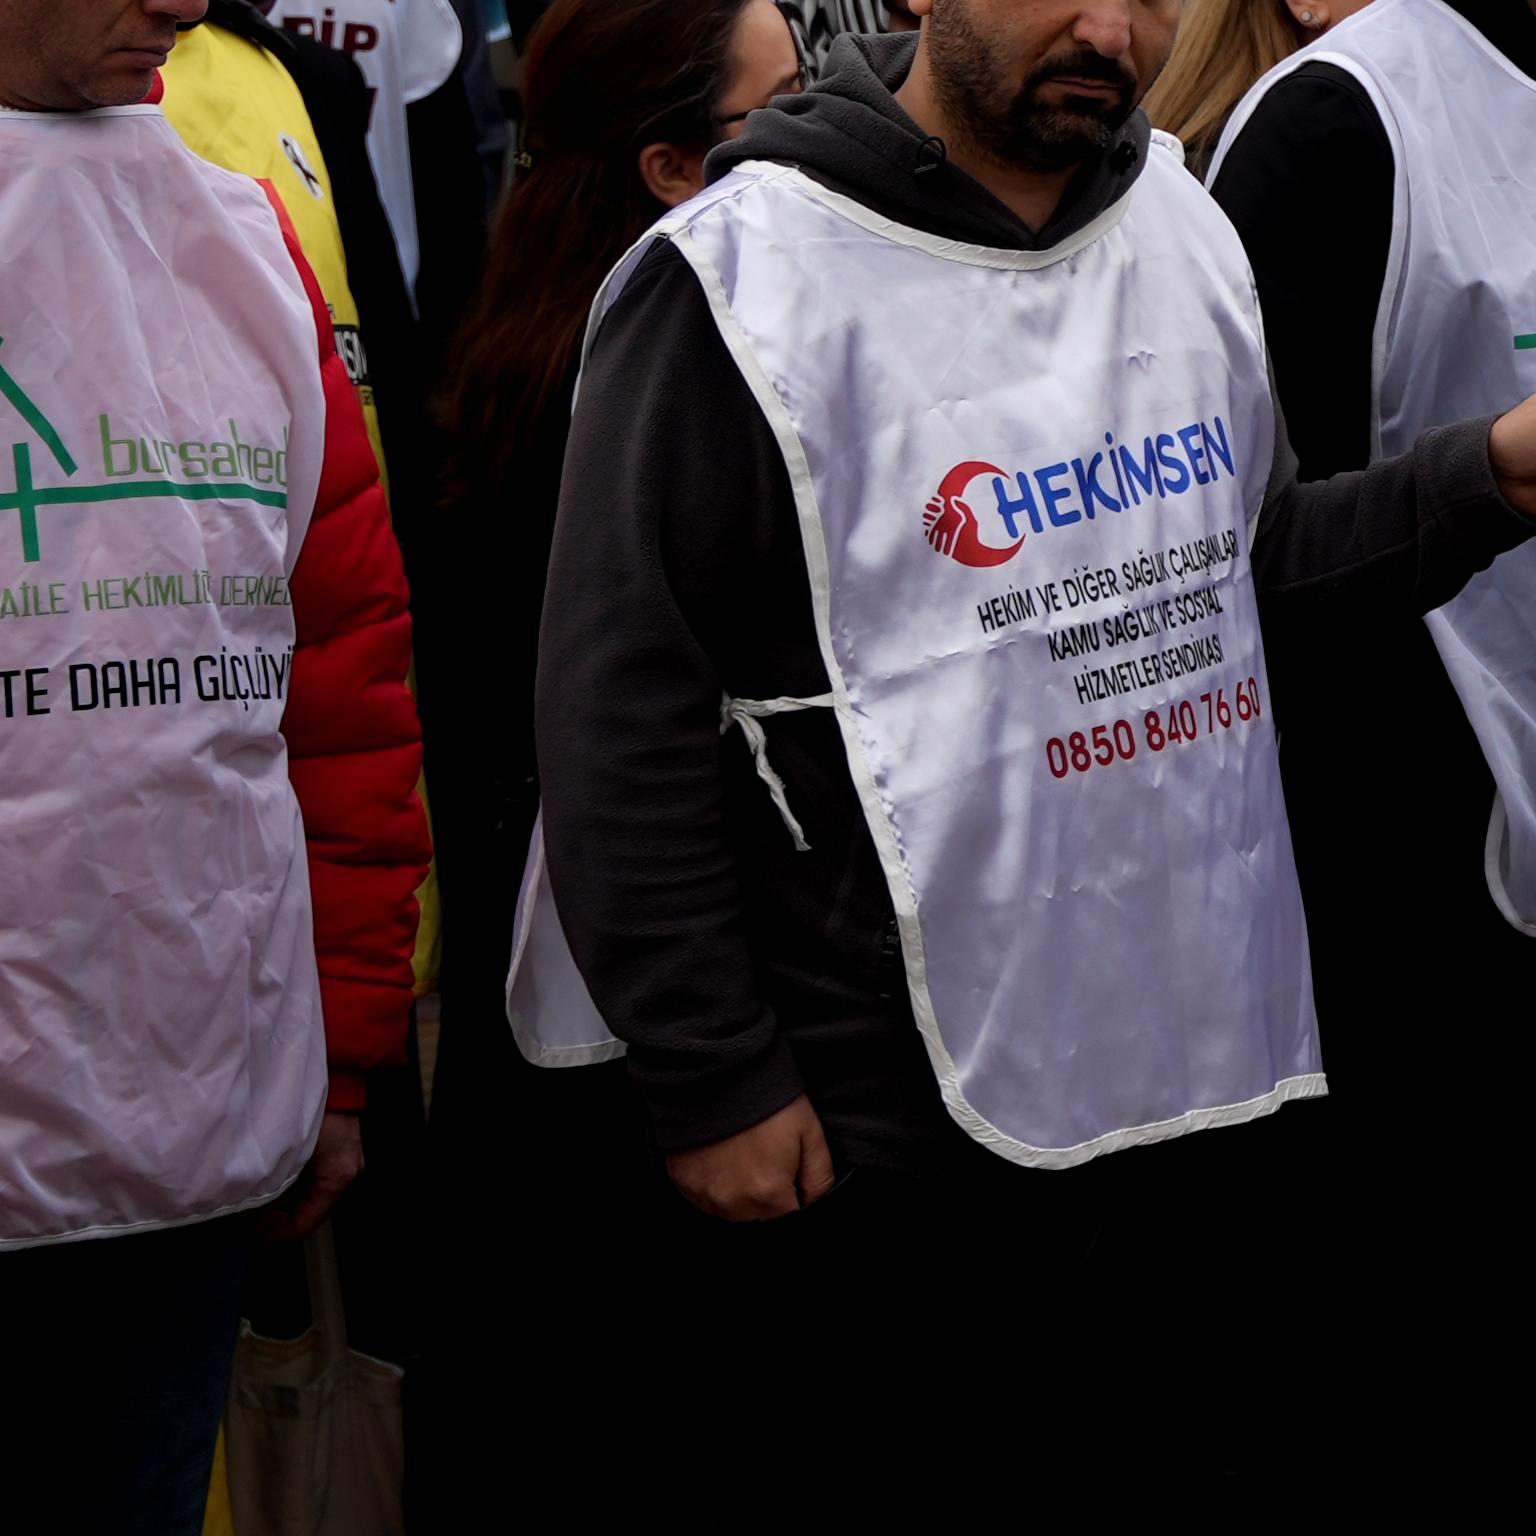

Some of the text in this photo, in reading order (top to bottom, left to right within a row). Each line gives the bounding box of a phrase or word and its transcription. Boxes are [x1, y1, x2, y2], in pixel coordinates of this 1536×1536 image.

[992, 417, 1236, 538] HEKİMSEN
[1, 583, 68, 619] AİLE
[977, 528, 1240, 633] HEKİM VE DİĞER SAĞLIK ÇALIŞANLARI
[1048, 585, 1223, 662] KAMU SAĞLIK VE SOSYAL
[1161, 633, 1225, 678] SENDİKASI
[69, 657, 180, 712] DAHA
[1046, 677, 1260, 778] 0850 840 76 60
